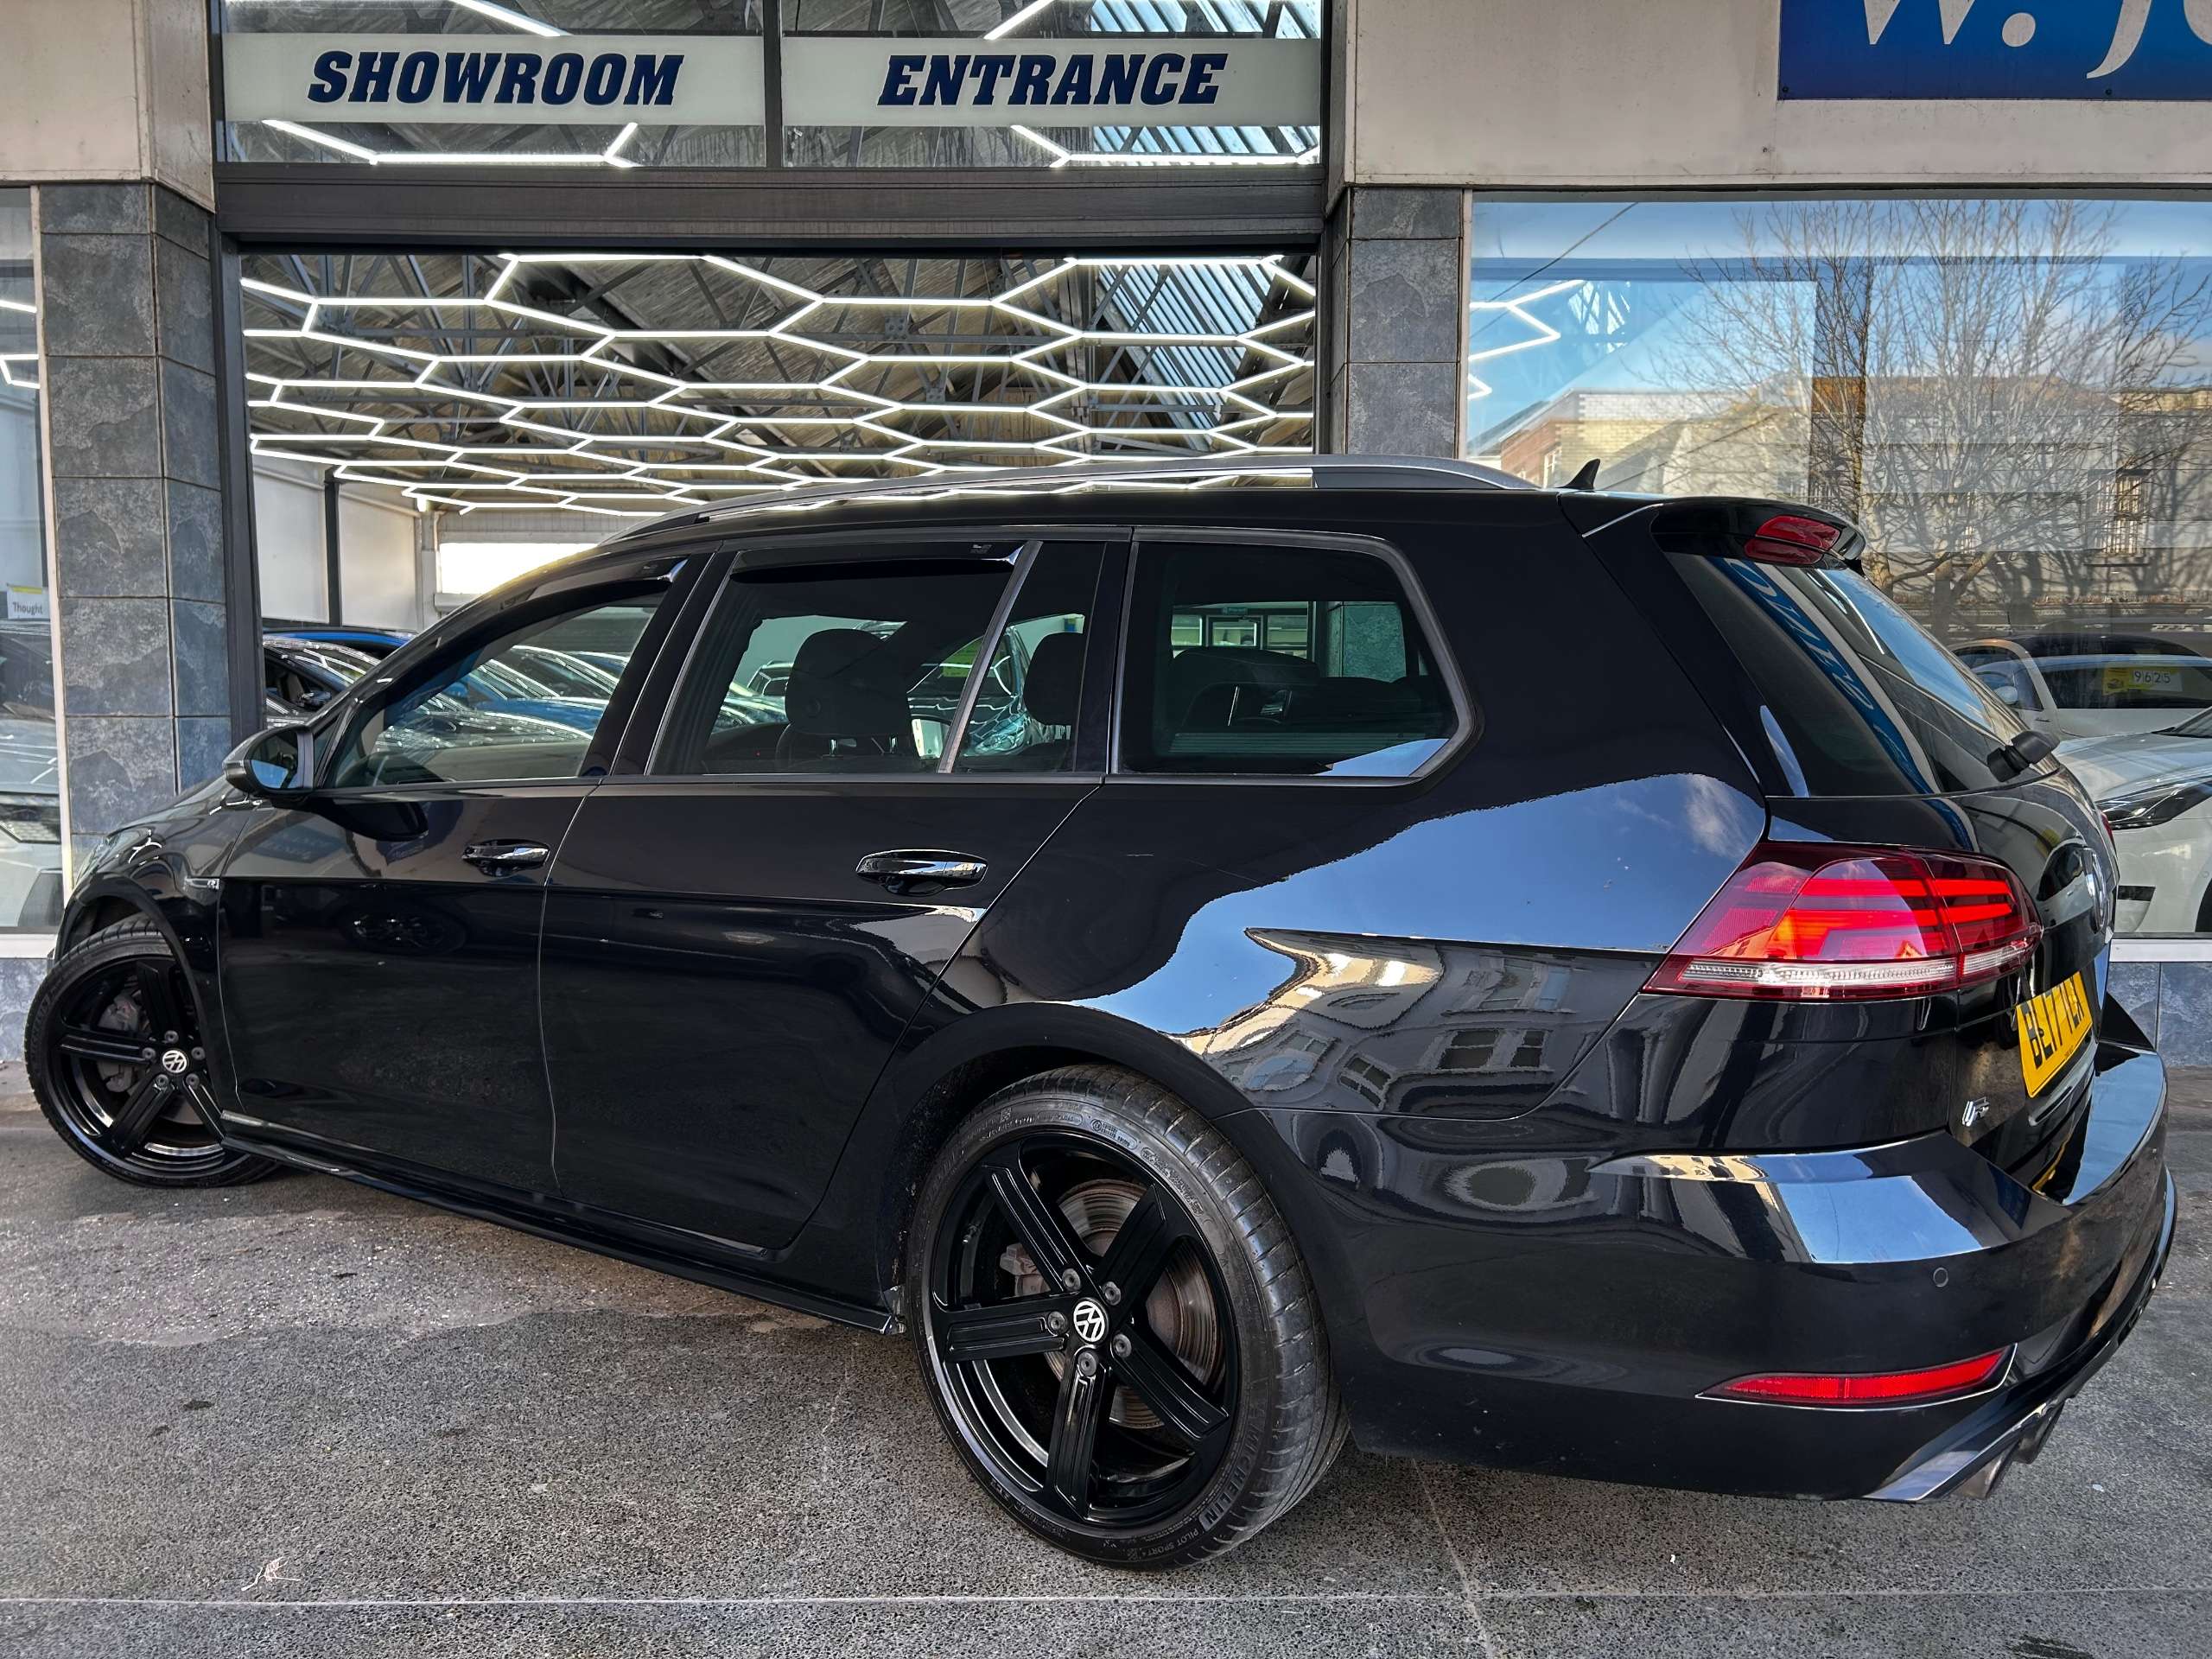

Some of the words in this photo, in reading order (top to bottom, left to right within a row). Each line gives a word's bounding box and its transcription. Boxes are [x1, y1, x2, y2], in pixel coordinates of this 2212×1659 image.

[308, 51, 684, 106] SHOWROOM
[877, 53, 1229, 105] ENTRANCE
[2134, 671, 2171, 683] 9625
